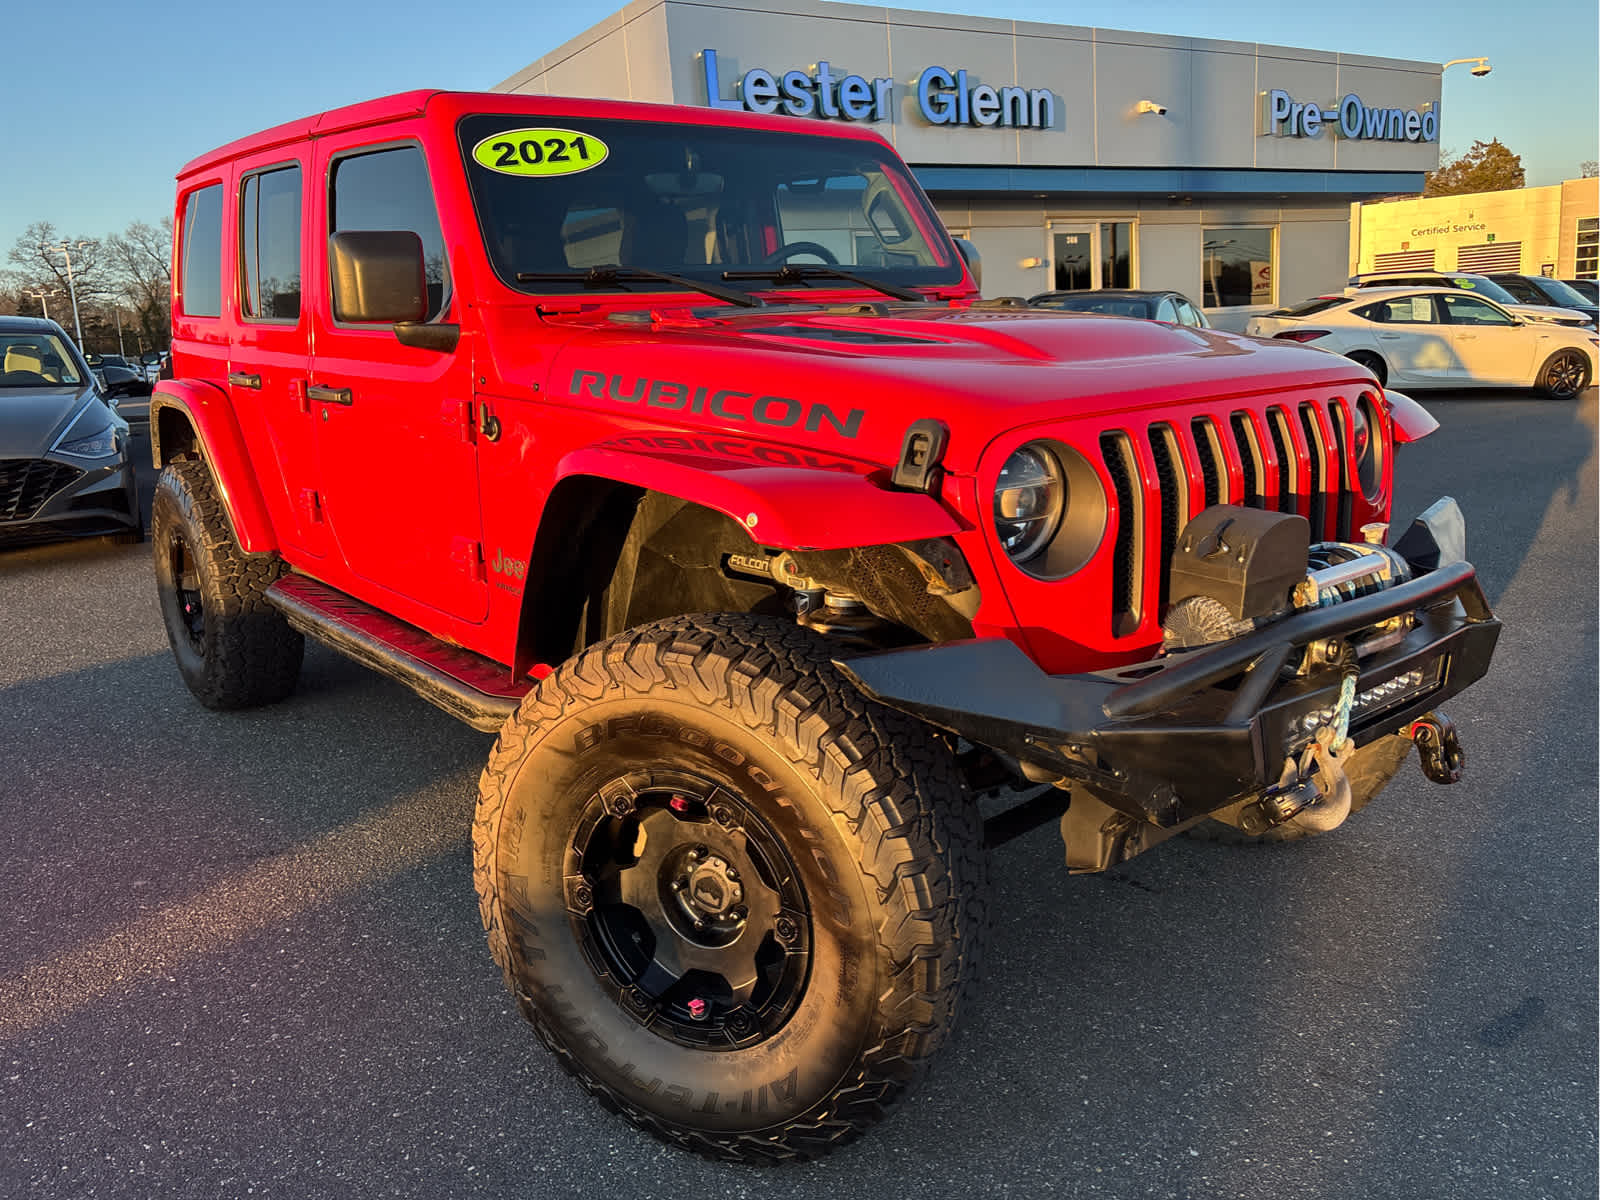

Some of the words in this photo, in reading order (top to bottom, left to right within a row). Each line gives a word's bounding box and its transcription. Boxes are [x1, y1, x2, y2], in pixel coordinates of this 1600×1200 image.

[703, 49, 893, 121] Lester
[917, 66, 1055, 128] Glenn
[1270, 89, 1439, 142] Pre-Owned
[492, 136, 589, 167] 2021
[1411, 225, 1450, 237] Certified
[1453, 223, 1487, 233] Service
[569, 369, 865, 439] RUBICON
[731, 554, 769, 572] FALCON
